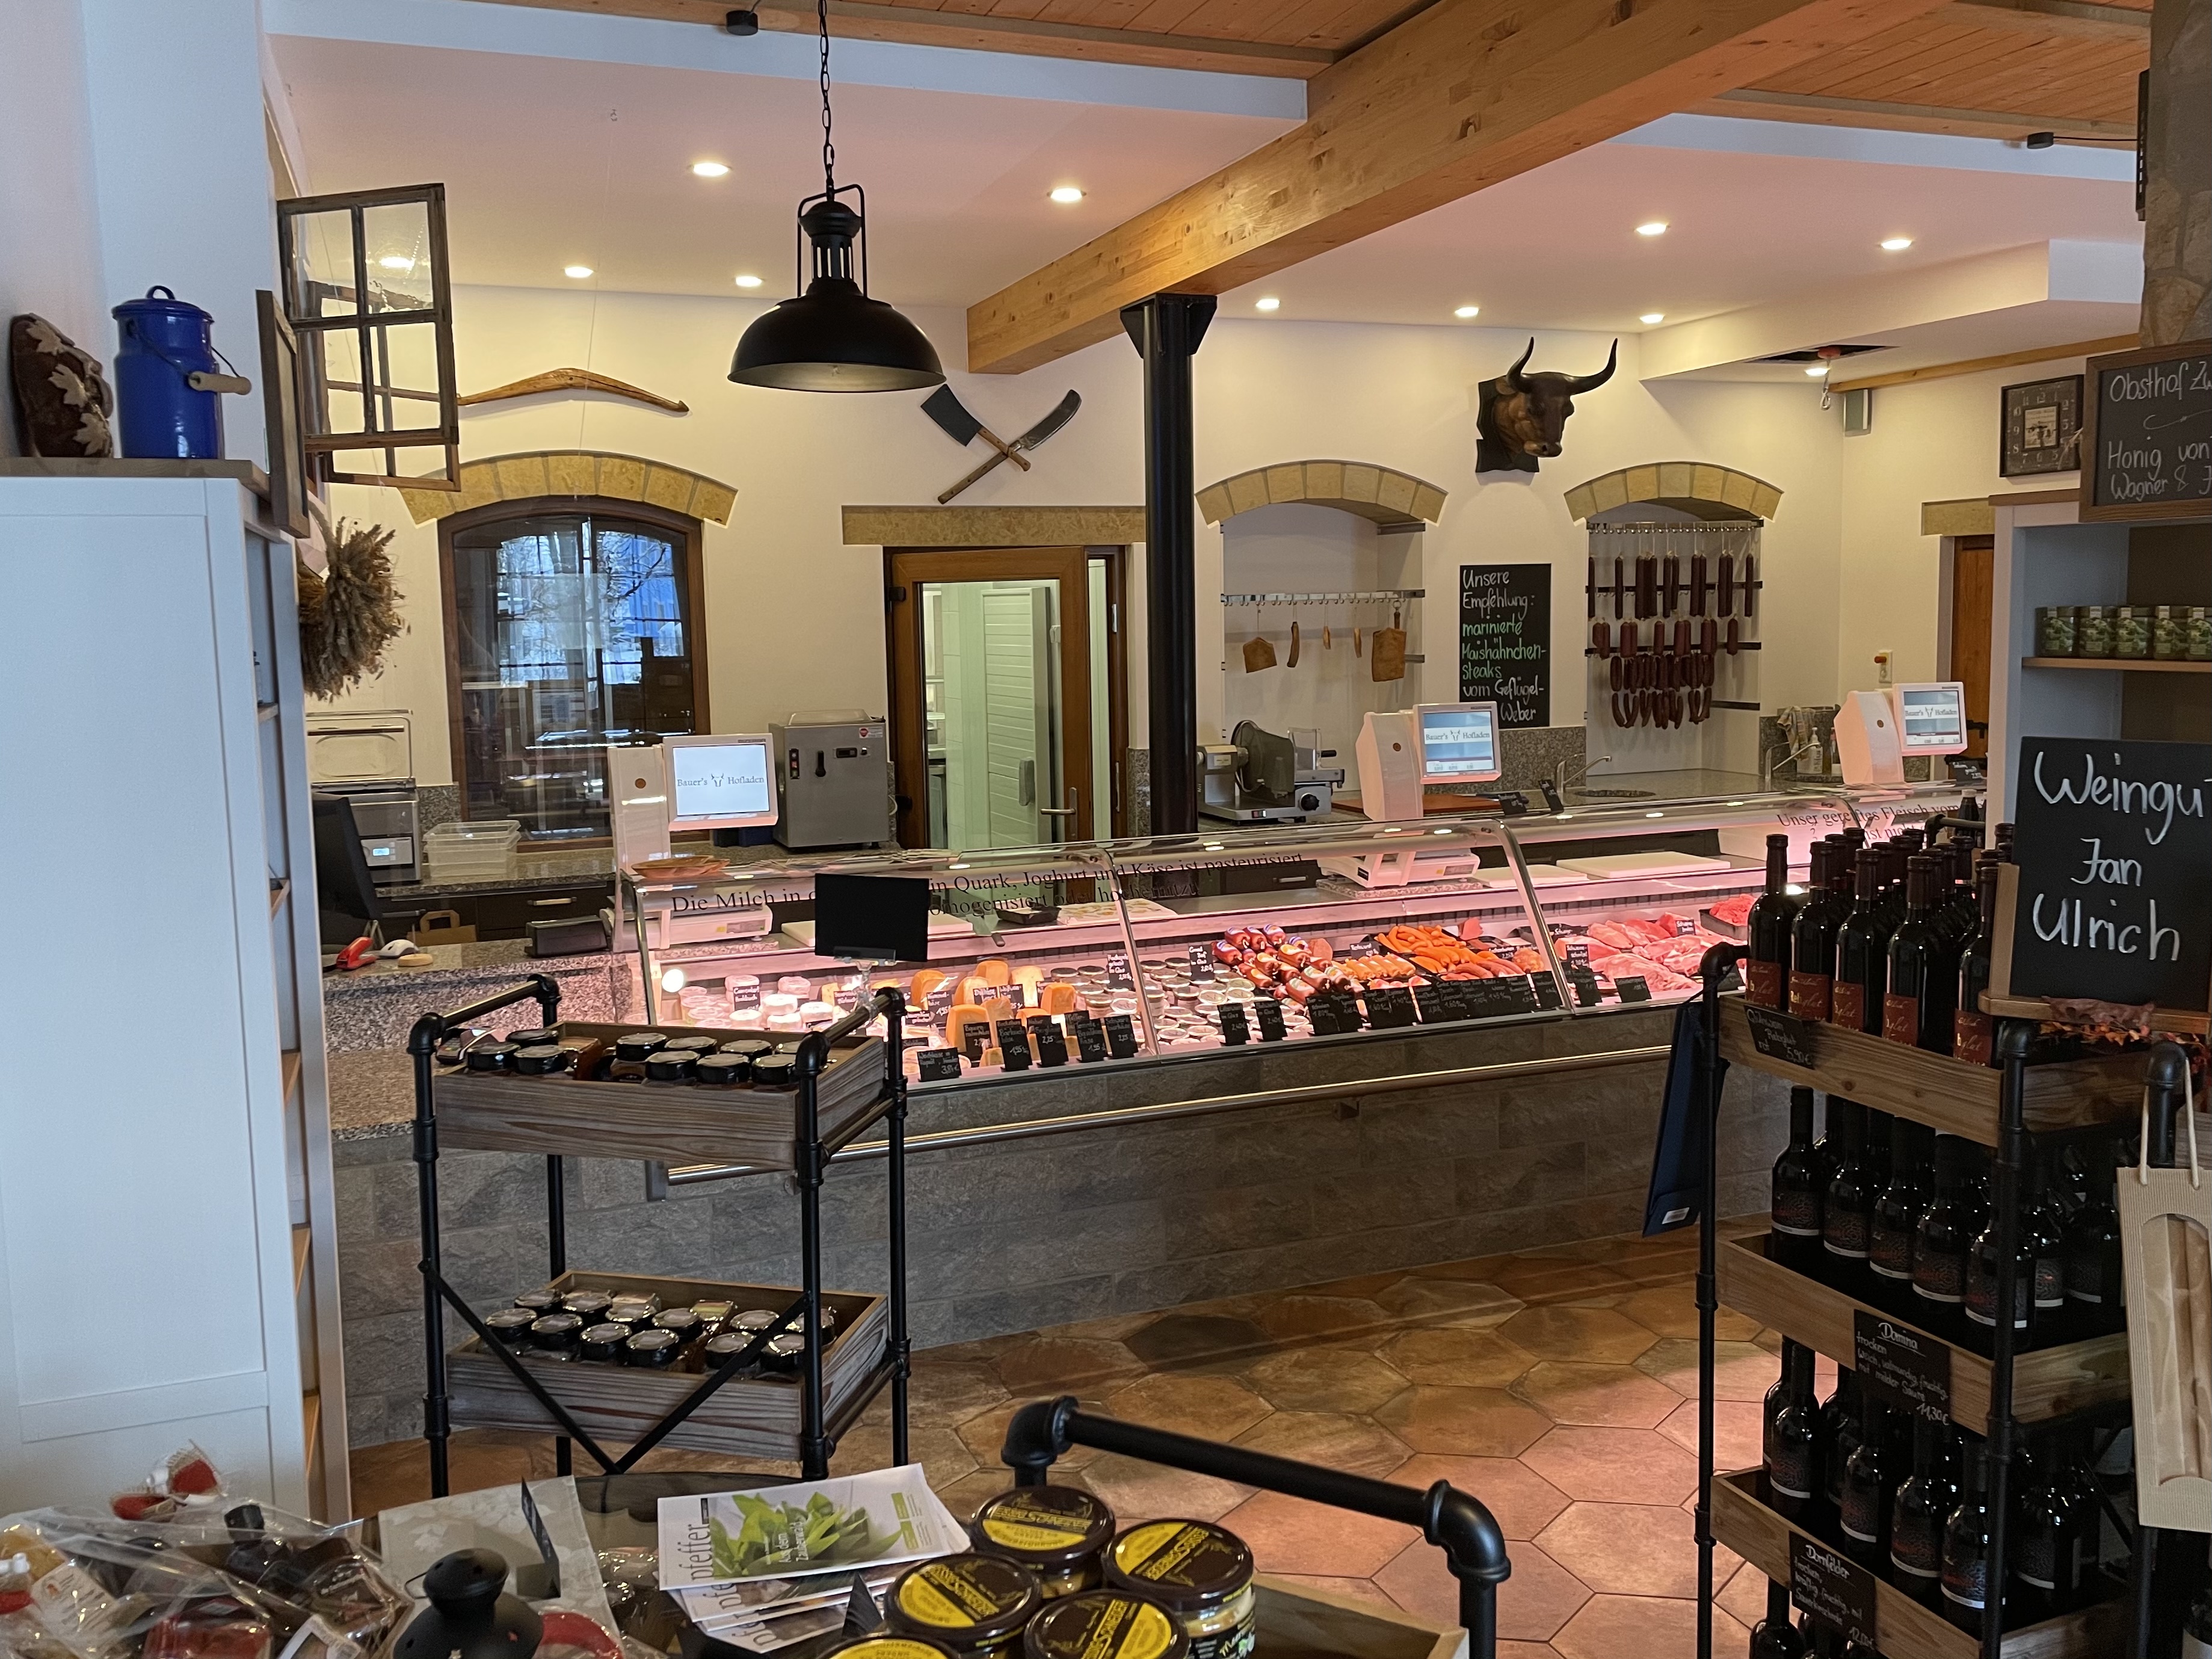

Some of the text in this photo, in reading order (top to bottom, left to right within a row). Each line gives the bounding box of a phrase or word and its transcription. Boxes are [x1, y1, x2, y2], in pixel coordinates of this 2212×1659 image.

[2110, 362, 2189, 401] Obsthof
[2108, 436, 2161, 481] Honig
[2111, 473, 2167, 502] Wagner
[1462, 570, 1510, 589] Unsere
[1462, 588, 1535, 621] Empfehlung:
[1462, 613, 1523, 636] marinierte
[1462, 636, 1547, 660] Maishähnchen-
[1462, 660, 1502, 680] steaks
[1463, 675, 1544, 705] vom Geflügel-
[1500, 701, 1536, 722] Weber
[677, 775, 765, 787] Bauer's Hofladen
[1777, 813, 1819, 827] Unser
[1881, 804, 1927, 820] Fleisch
[2071, 838, 2142, 887] Jan
[954, 872, 1017, 895] Quark,
[1023, 867, 1086, 890] Joghurt
[1095, 863, 1127, 881] und
[1131, 860, 1174, 879] Käse
[1179, 858, 1198, 873] ist
[672, 895, 708, 913] Die
[715, 890, 775, 910] Milch
[783, 888, 802, 903] in
[929, 893, 1048, 919] omogenisiert
[2033, 893, 2180, 961] Ulrich
[1856, 1331, 1887, 1354] trocken
[1878, 1322, 1918, 1349] Domina
[679, 1523, 714, 1582] pfeffer
